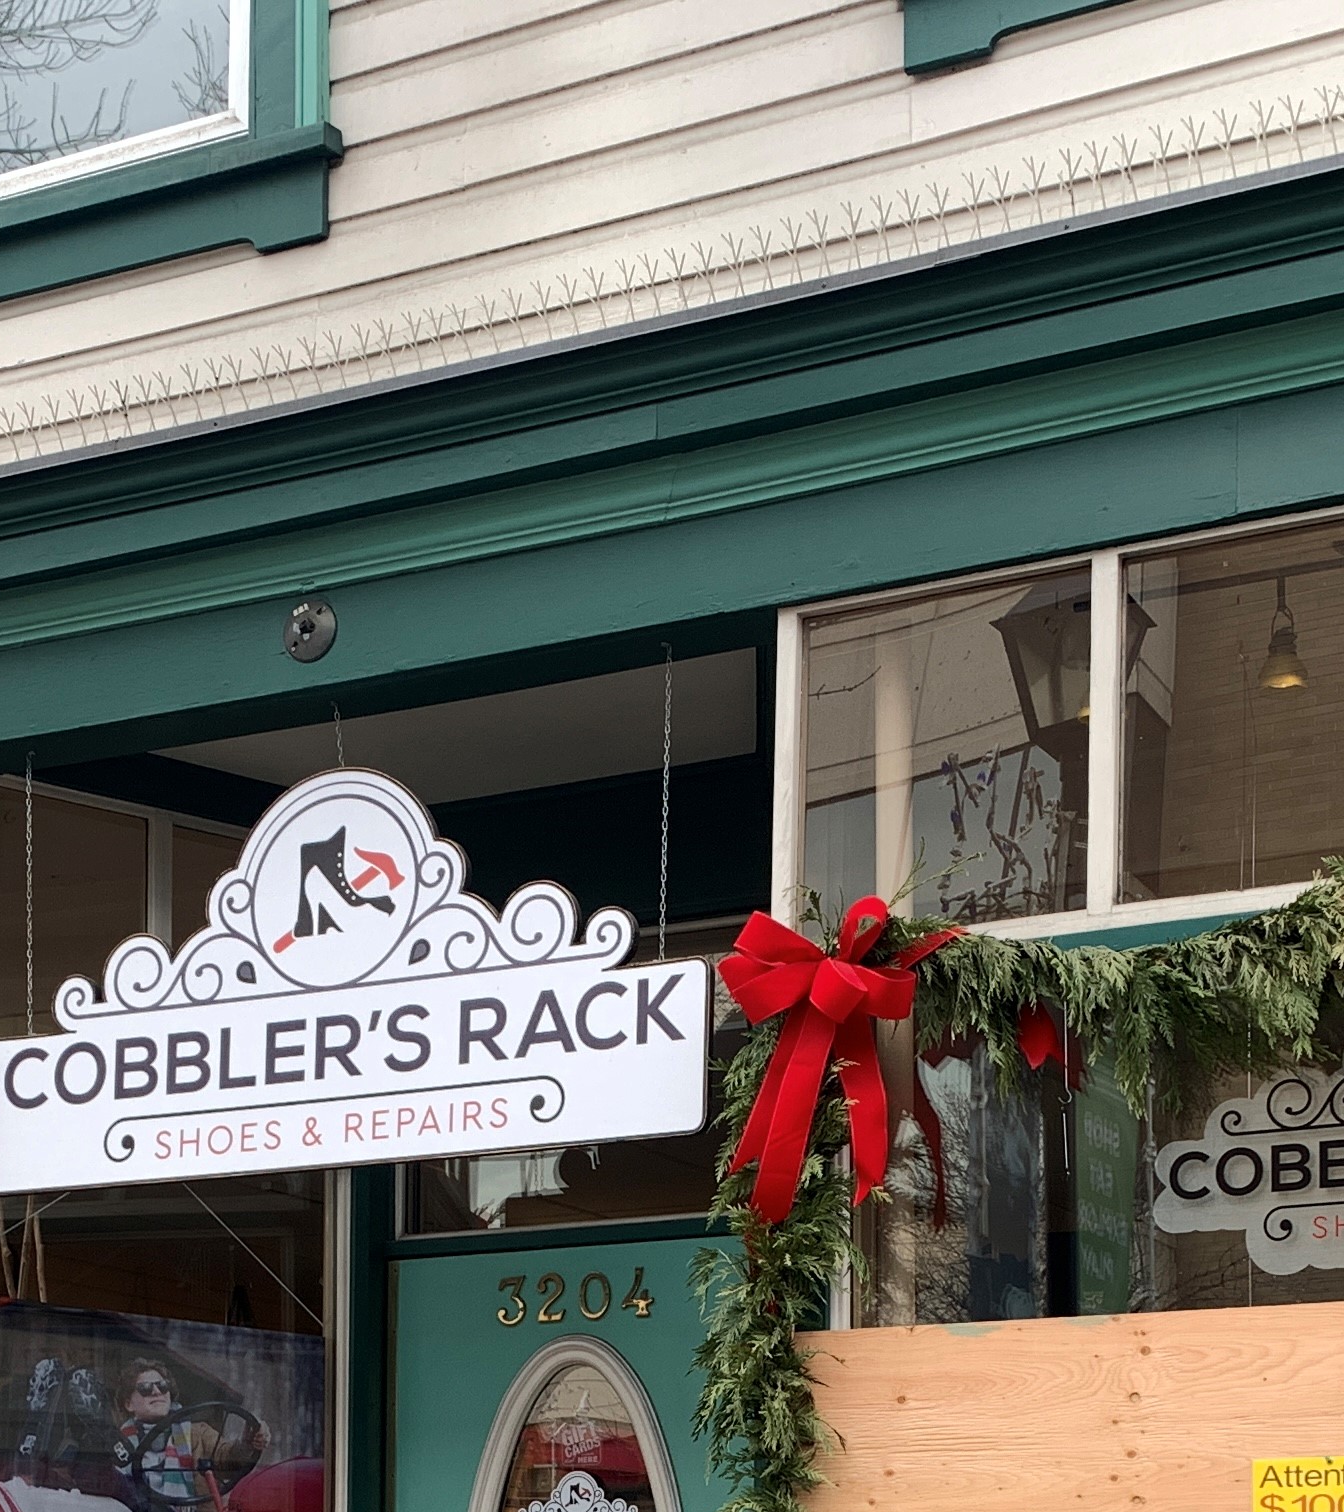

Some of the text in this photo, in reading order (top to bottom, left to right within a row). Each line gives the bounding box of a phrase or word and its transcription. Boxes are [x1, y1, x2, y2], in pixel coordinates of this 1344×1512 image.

[3, 972, 687, 1110] COBBLER'S RACK
[153, 1097, 510, 1161] SHOES & REPAIRS
[497, 1266, 655, 1326] 3204
[564, 1437, 601, 1459] CARDS
